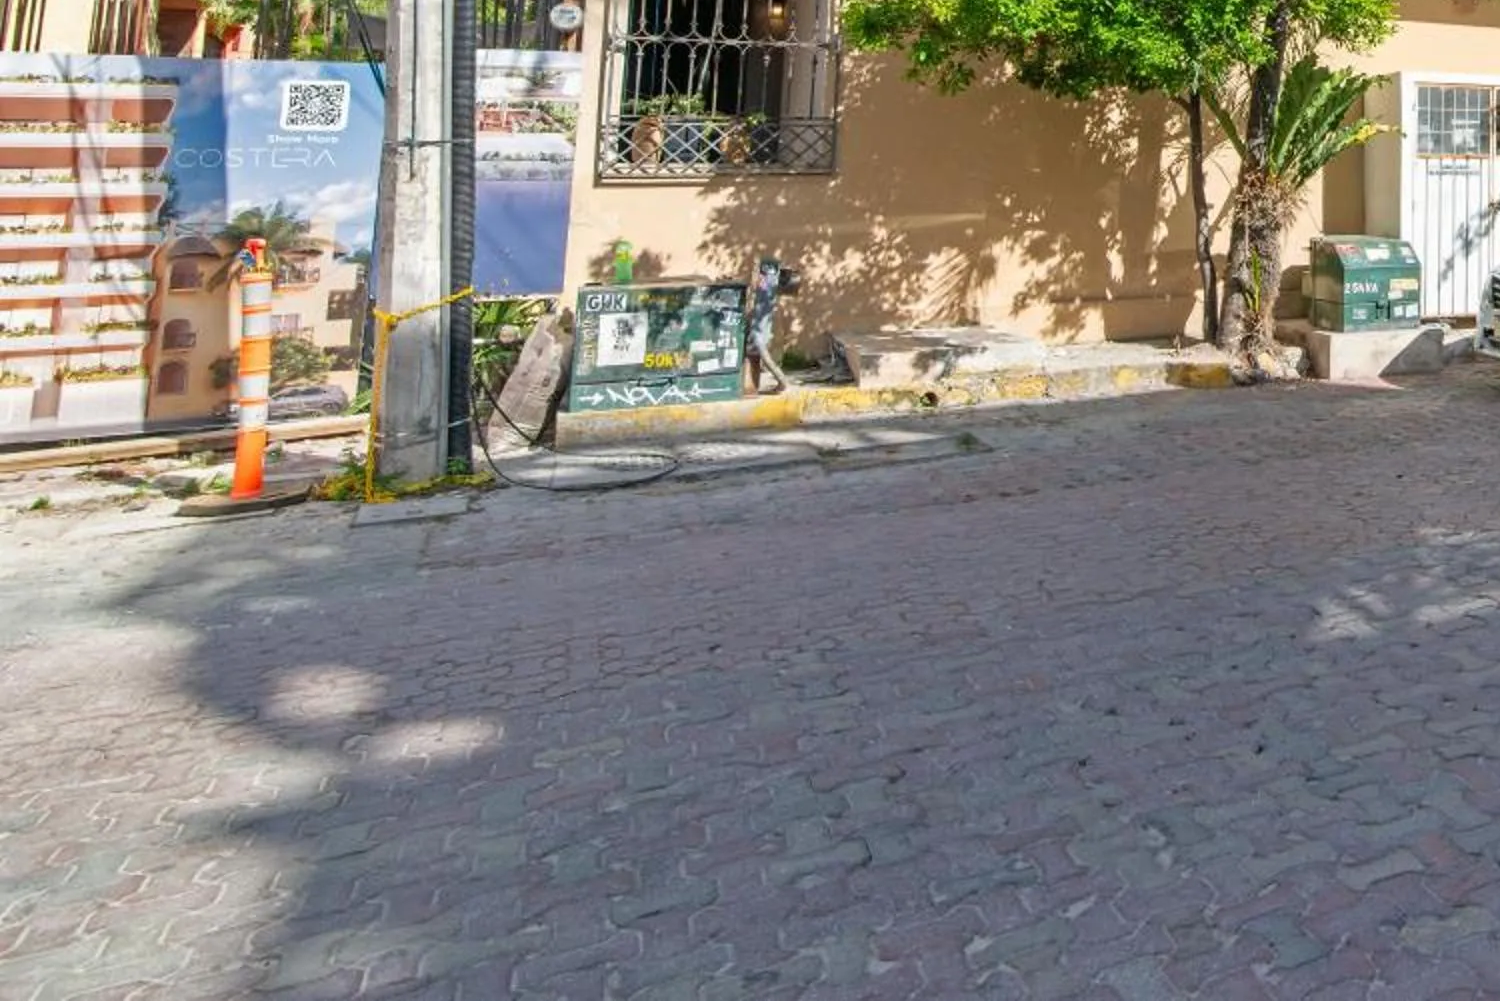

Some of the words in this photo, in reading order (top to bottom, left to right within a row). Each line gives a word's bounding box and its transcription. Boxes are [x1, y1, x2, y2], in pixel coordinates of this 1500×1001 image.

[267, 135, 301, 144] Show
[307, 135, 339, 144] More
[174, 148, 337, 169] COSTERA
